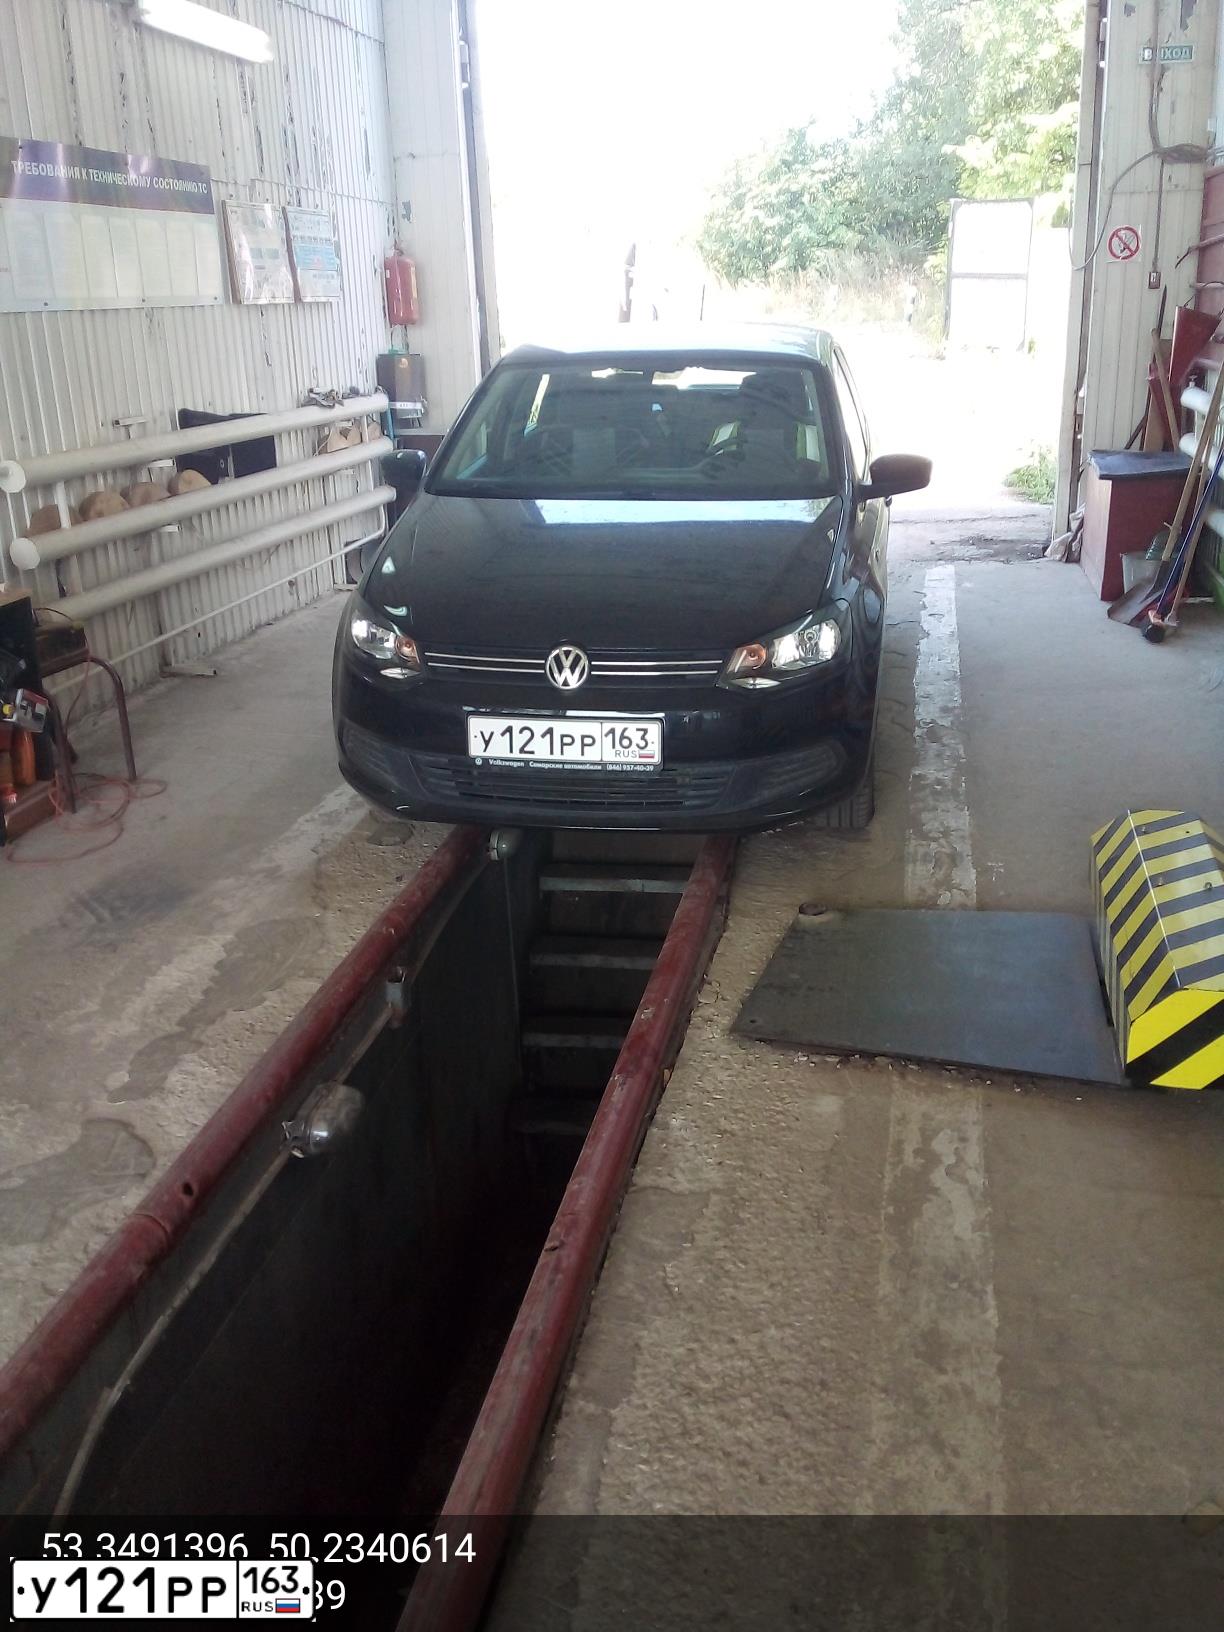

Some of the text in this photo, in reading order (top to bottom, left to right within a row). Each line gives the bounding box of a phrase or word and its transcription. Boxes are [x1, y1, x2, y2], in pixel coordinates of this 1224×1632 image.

[11, 160, 80, 180] ТРЕБОВАНИЯ
[81, 167, 88, 180] К
[88, 168, 151, 188] ТЕХНИЧЕСКОМУ
[199, 182, 208, 194] ТС
[604, 726, 649, 751] 163
[615, 750, 637, 759] RUS
